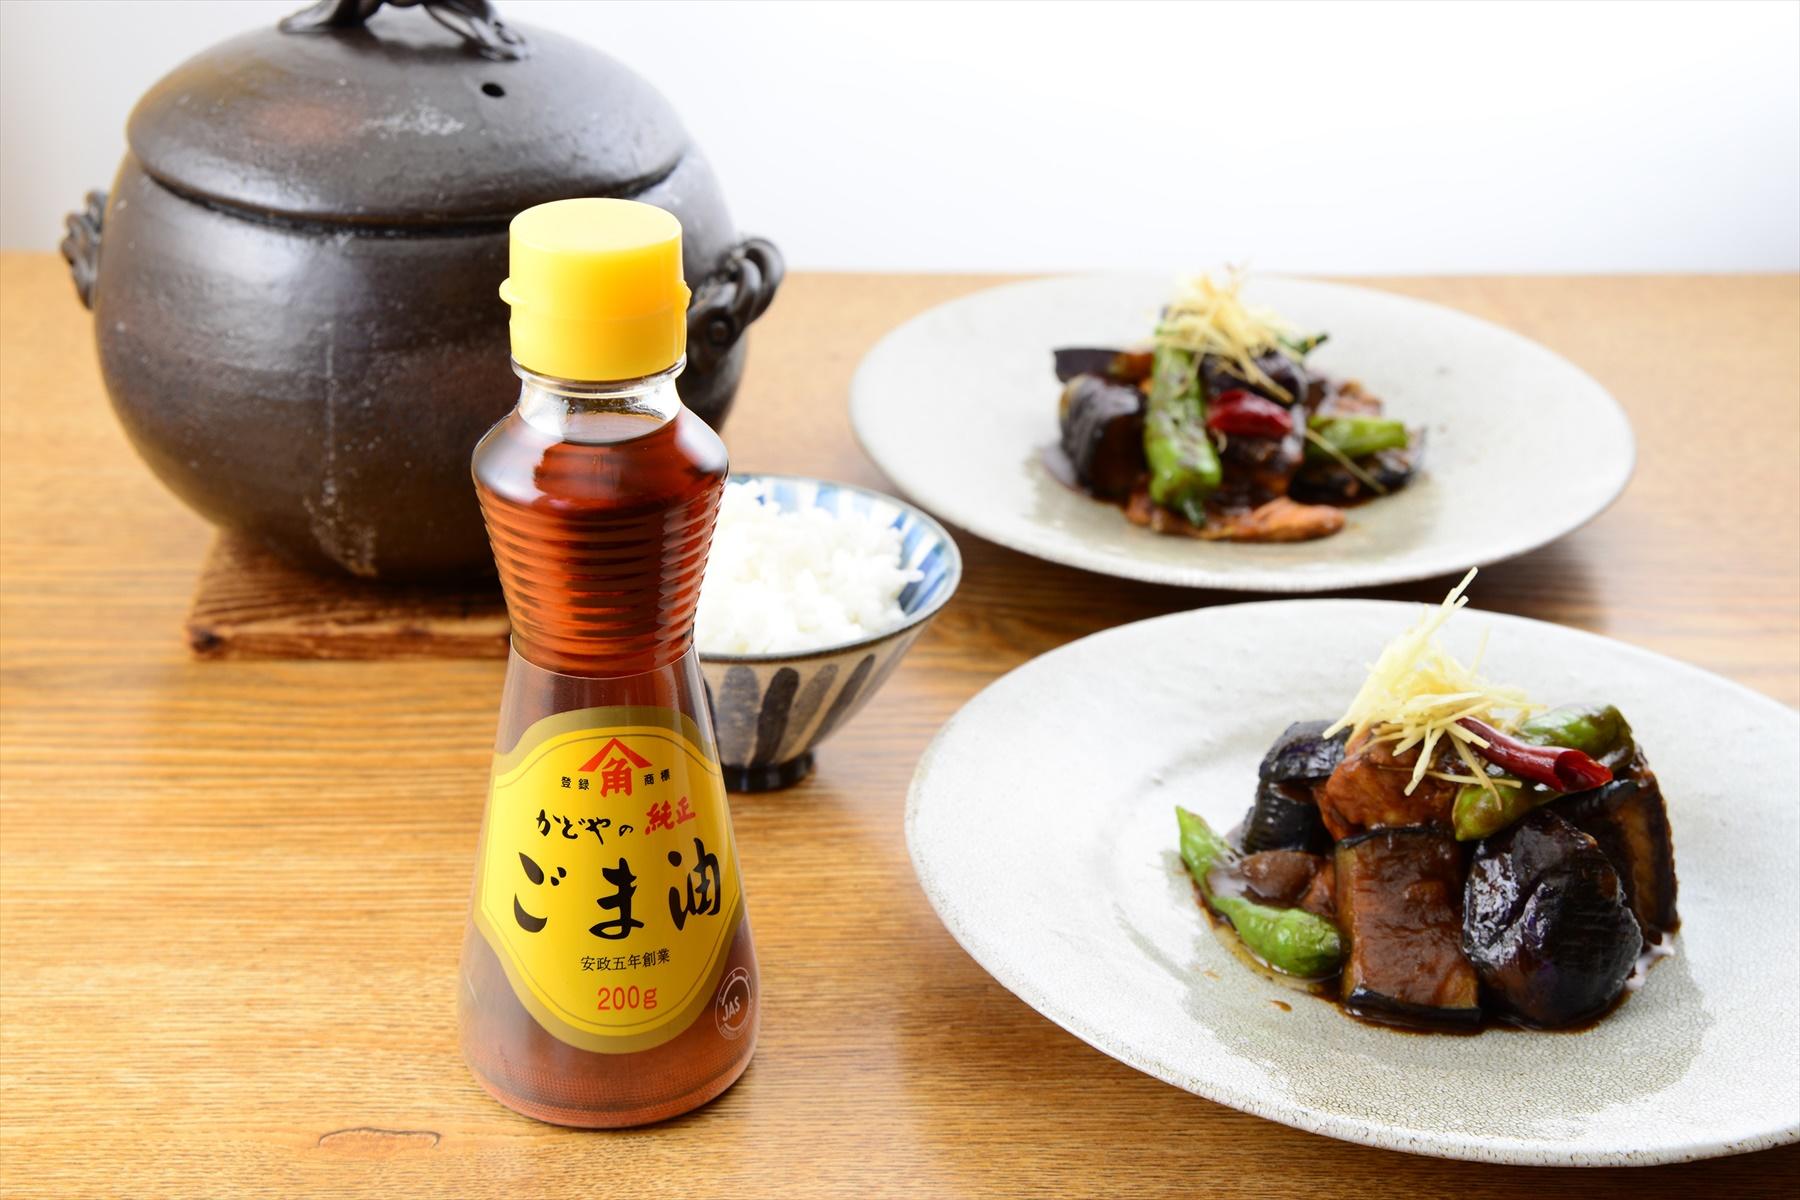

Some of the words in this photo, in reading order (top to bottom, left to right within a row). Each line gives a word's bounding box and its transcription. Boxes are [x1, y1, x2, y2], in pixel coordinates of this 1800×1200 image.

[560, 775, 590, 791] 登録
[644, 768, 671, 786] 商標
[535, 808, 634, 845] かどやの
[644, 796, 696, 836] 純正
[513, 837, 722, 941] ごま油
[580, 948, 671, 973] 安政五年創業
[597, 985, 658, 1011] 200g
[722, 995, 741, 1023] JAS
